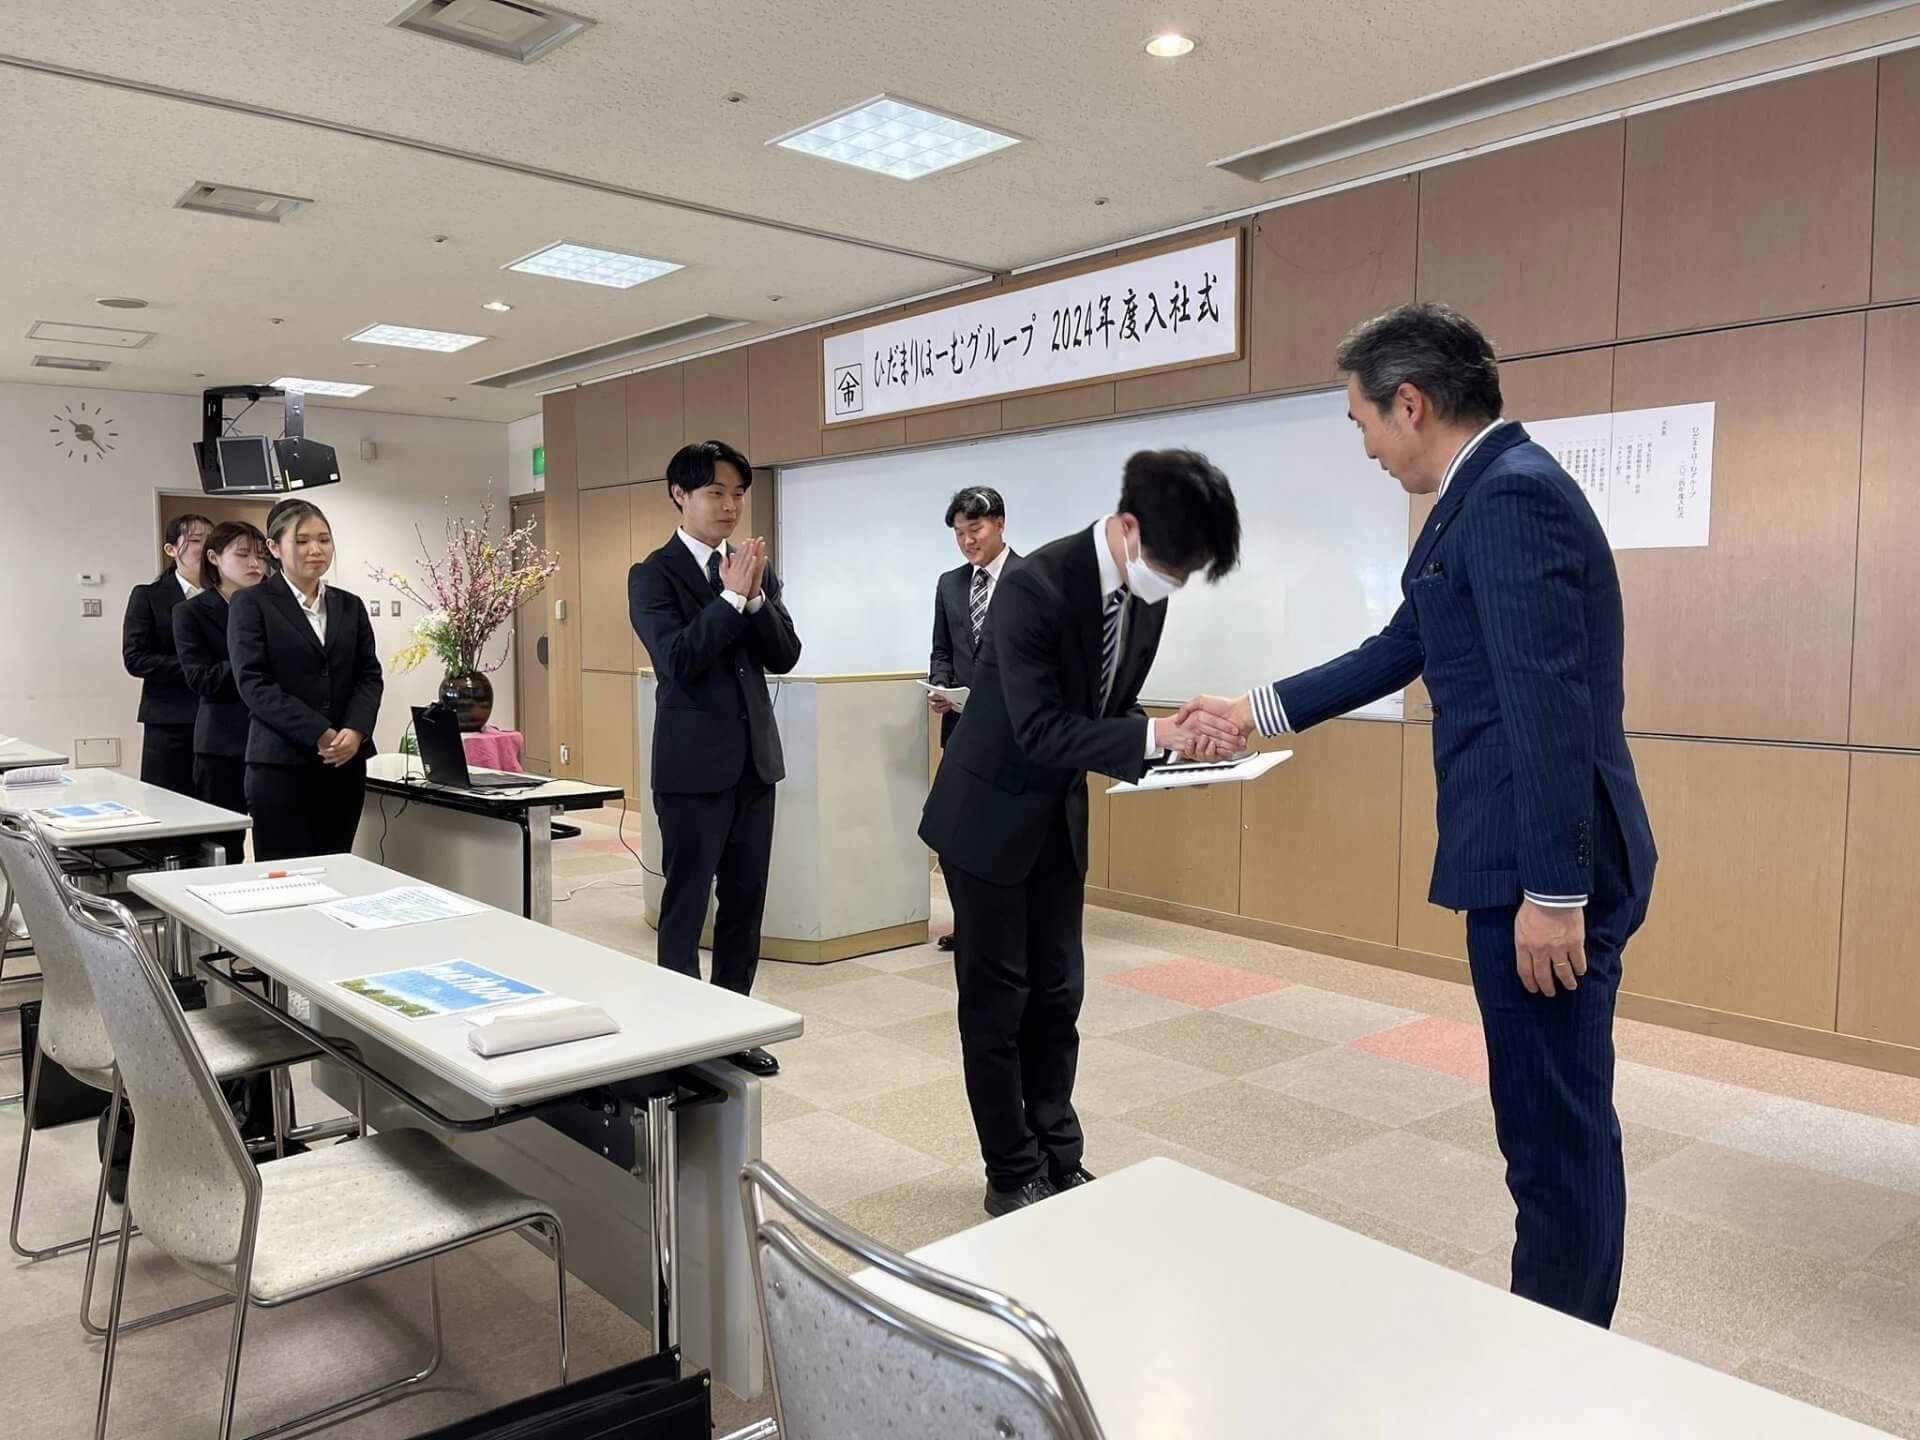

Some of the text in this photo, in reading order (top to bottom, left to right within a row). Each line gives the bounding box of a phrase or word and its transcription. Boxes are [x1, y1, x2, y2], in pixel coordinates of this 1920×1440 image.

[874, 272, 1219, 388] ひだまりほーむグループ 2024年度入社式
